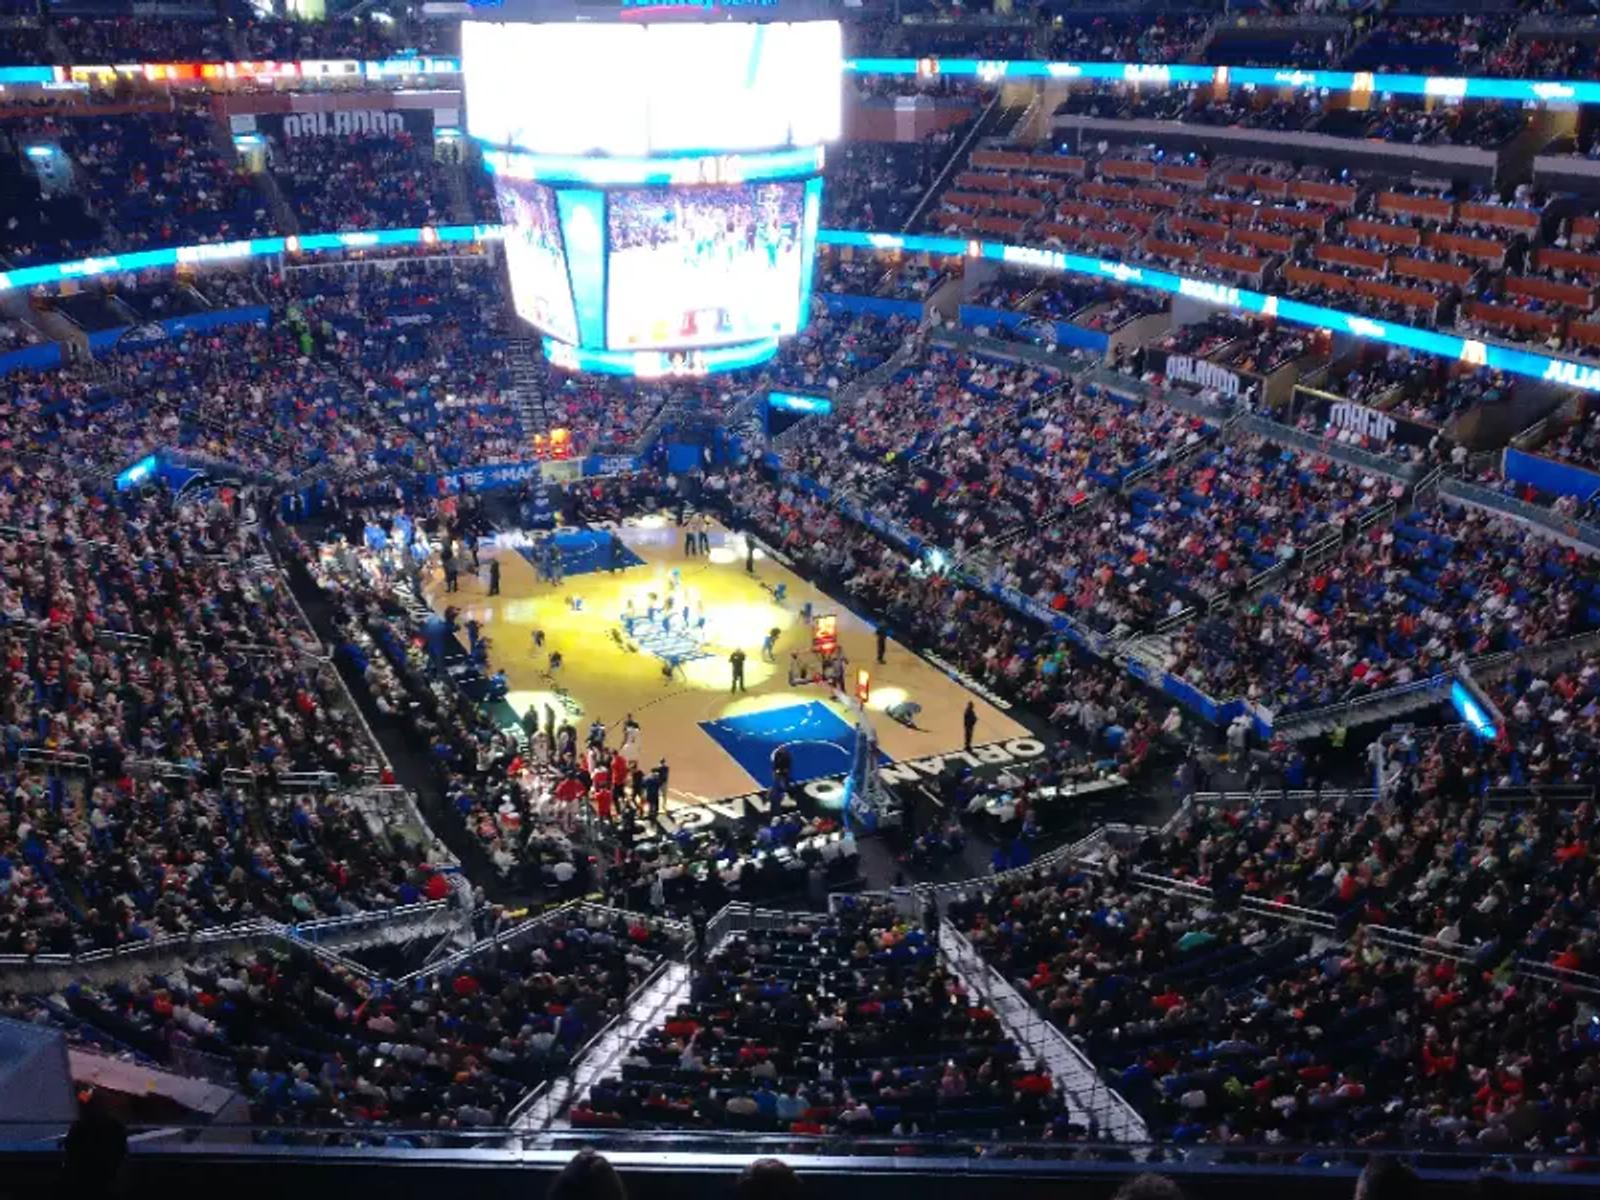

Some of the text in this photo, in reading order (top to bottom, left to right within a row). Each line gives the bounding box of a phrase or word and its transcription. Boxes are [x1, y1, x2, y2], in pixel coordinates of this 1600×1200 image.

[284, 108, 404, 138] ORLANDO
[1166, 355, 1240, 397] ORLANDO
[1330, 403, 1397, 441] MAGIC
[803, 738, 1046, 809] ORLANO
